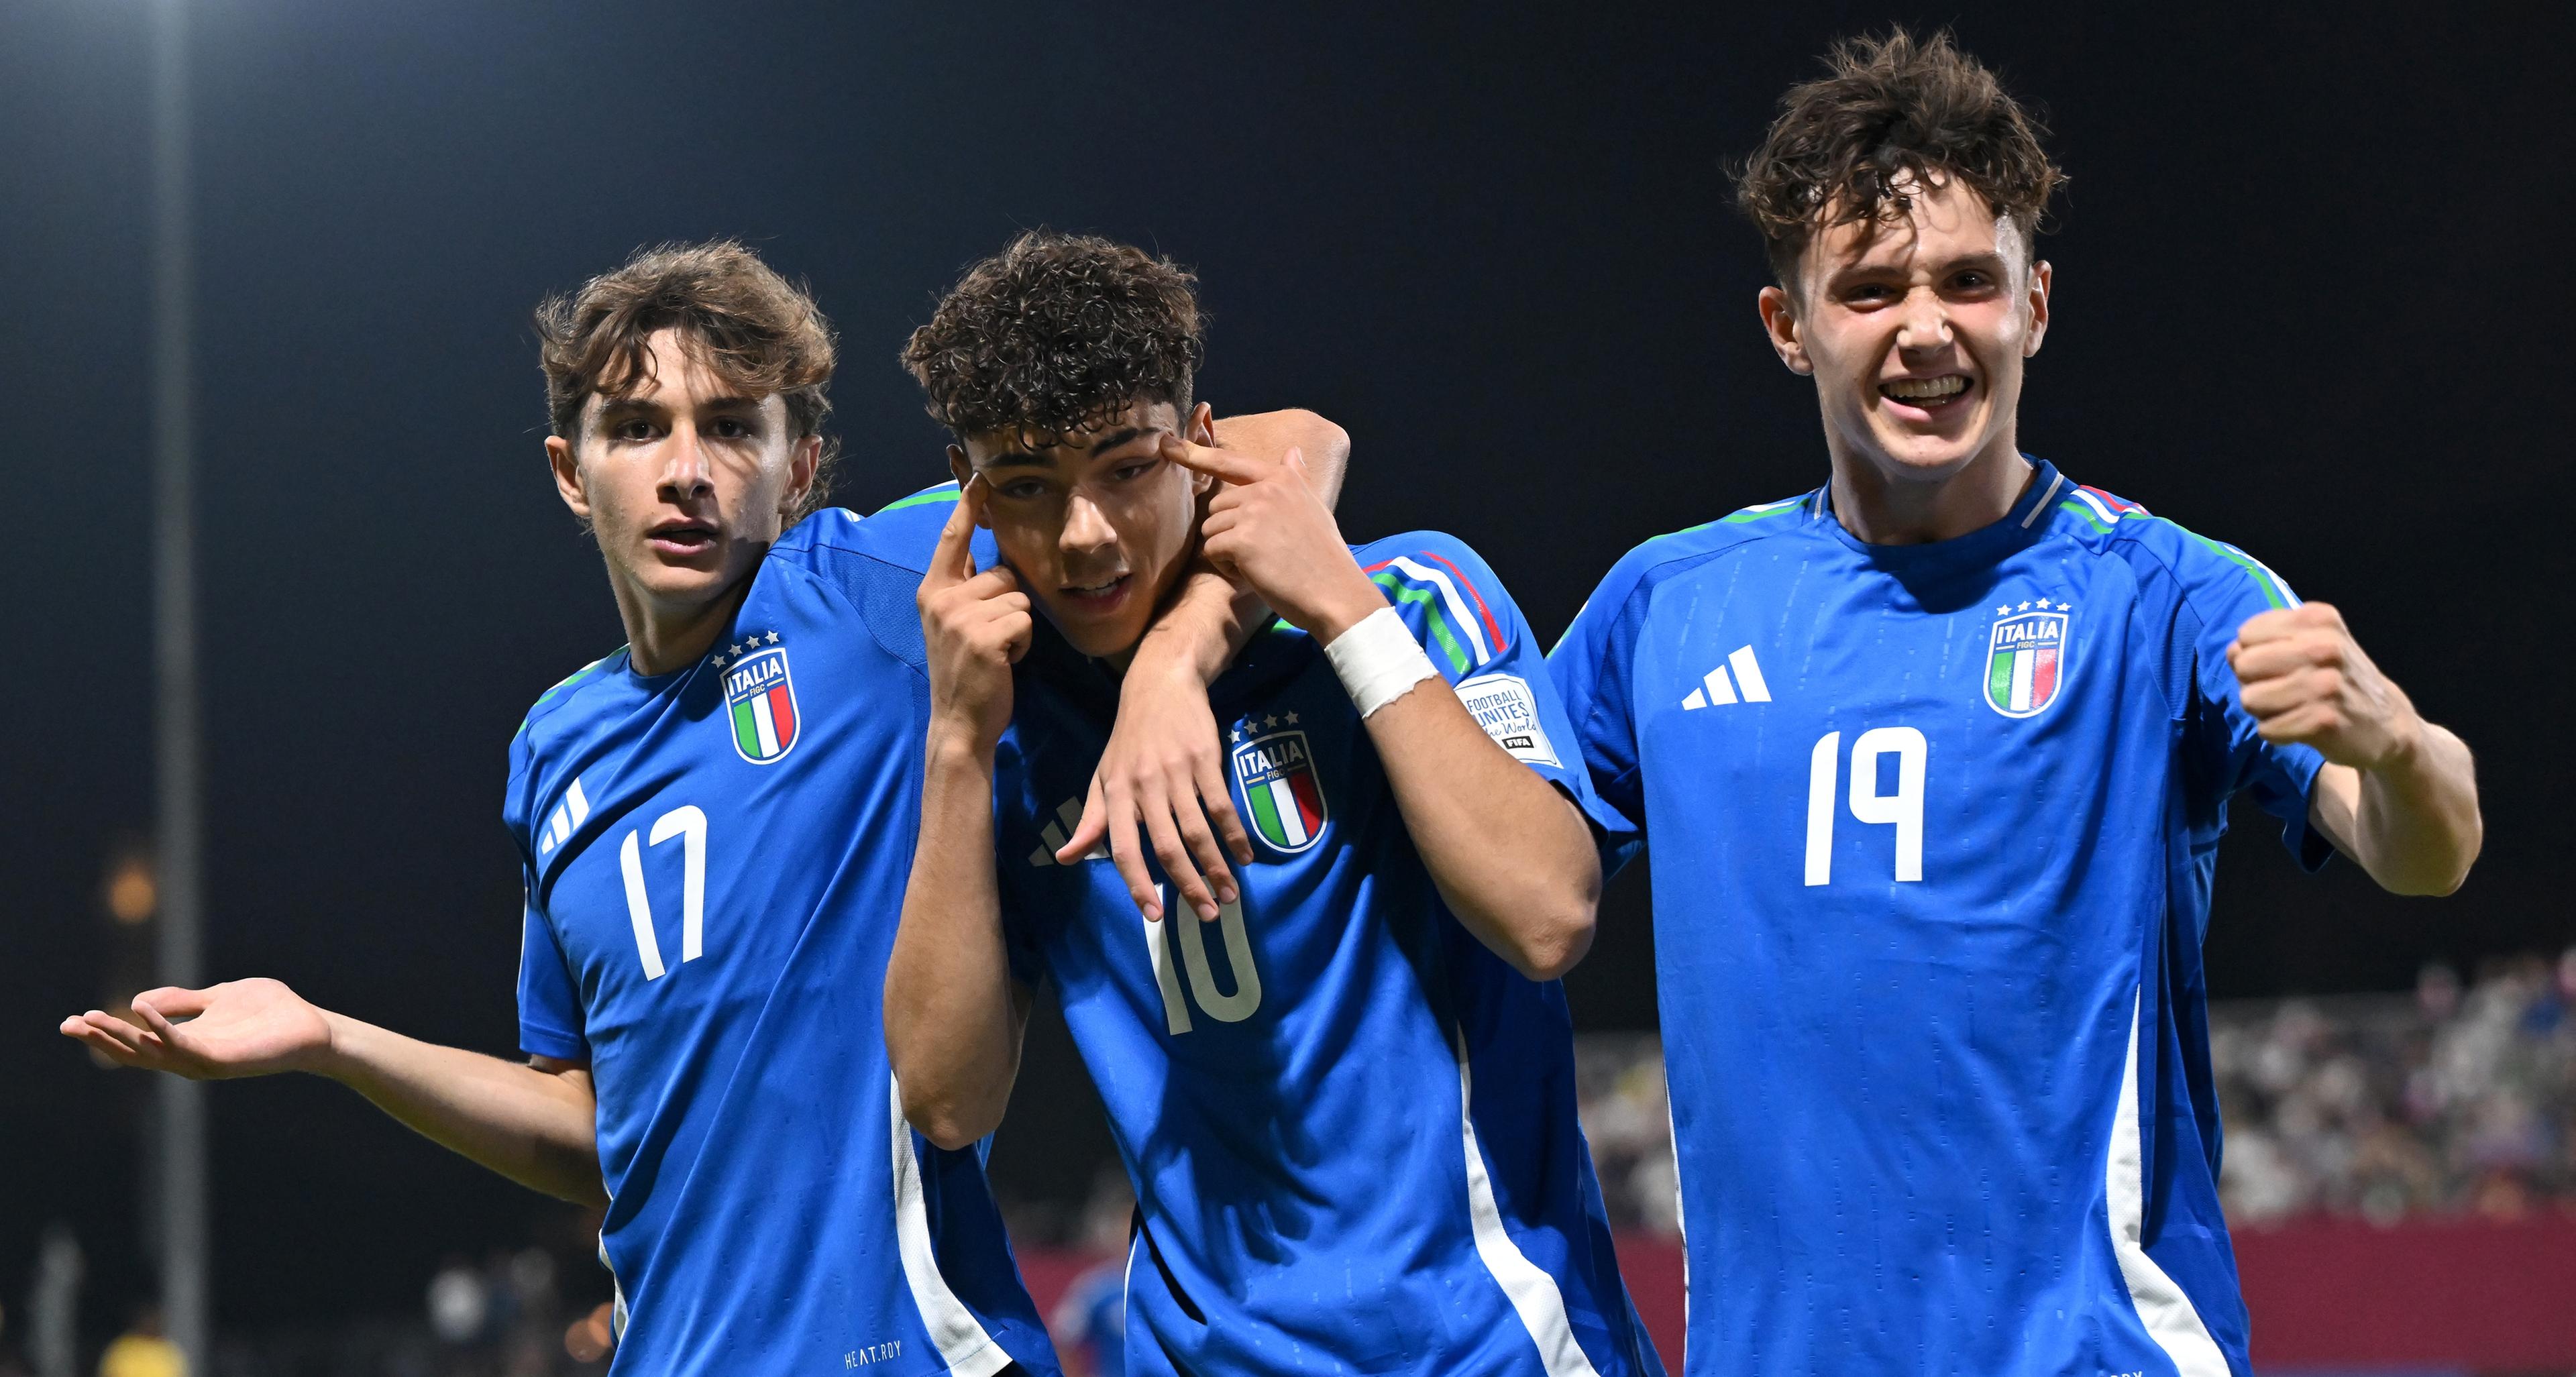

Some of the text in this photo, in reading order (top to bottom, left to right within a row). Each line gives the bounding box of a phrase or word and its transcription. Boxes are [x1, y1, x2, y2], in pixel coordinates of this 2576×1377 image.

[1996, 620, 2058, 644] ITALIA
[2017, 641, 2035, 649] FIGC
[727, 657, 783, 696] ITALIA
[749, 683, 765, 697] FIGC
[1466, 690, 1521, 712] FOOTBALL
[1506, 738, 1531, 747] FIFA
[1239, 740, 1304, 777] ITALIA
[1266, 768, 1286, 780] FIGC
[1805, 726, 1927, 887] 19
[619, 805, 708, 981] 17
[1142, 875, 1262, 1036] 10
[845, 1340, 900, 1370] HEAT.RDY
